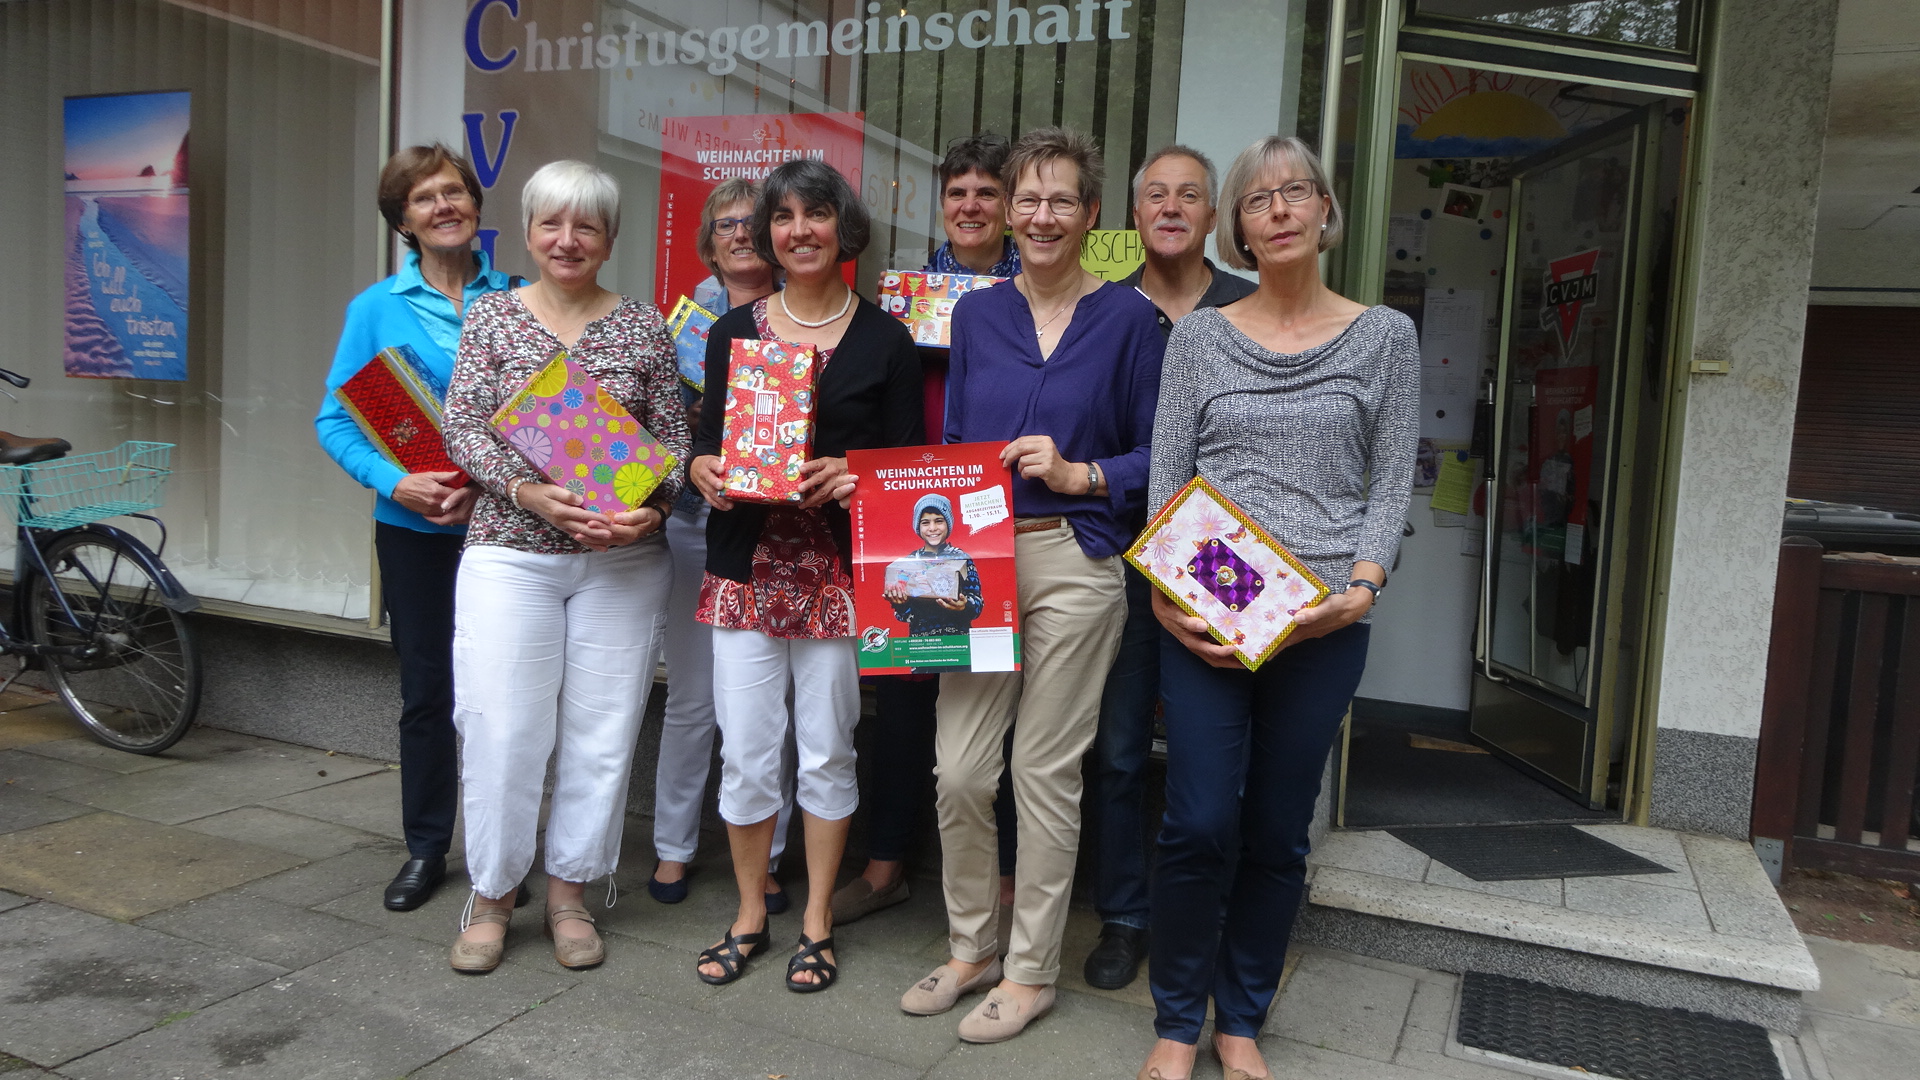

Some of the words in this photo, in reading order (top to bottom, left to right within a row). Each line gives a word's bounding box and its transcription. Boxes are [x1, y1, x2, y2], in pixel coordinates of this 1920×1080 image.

[697, 149, 802, 163] WEIHNACHTEN
[806, 149, 824, 163] IM
[703, 166, 778, 180] SCHUHKA
[1549, 278, 1593, 304] CVJM
[757, 414, 773, 423] GIRL
[876, 465, 965, 479] WEIHNACHTEN
[968, 464, 983, 475] IM
